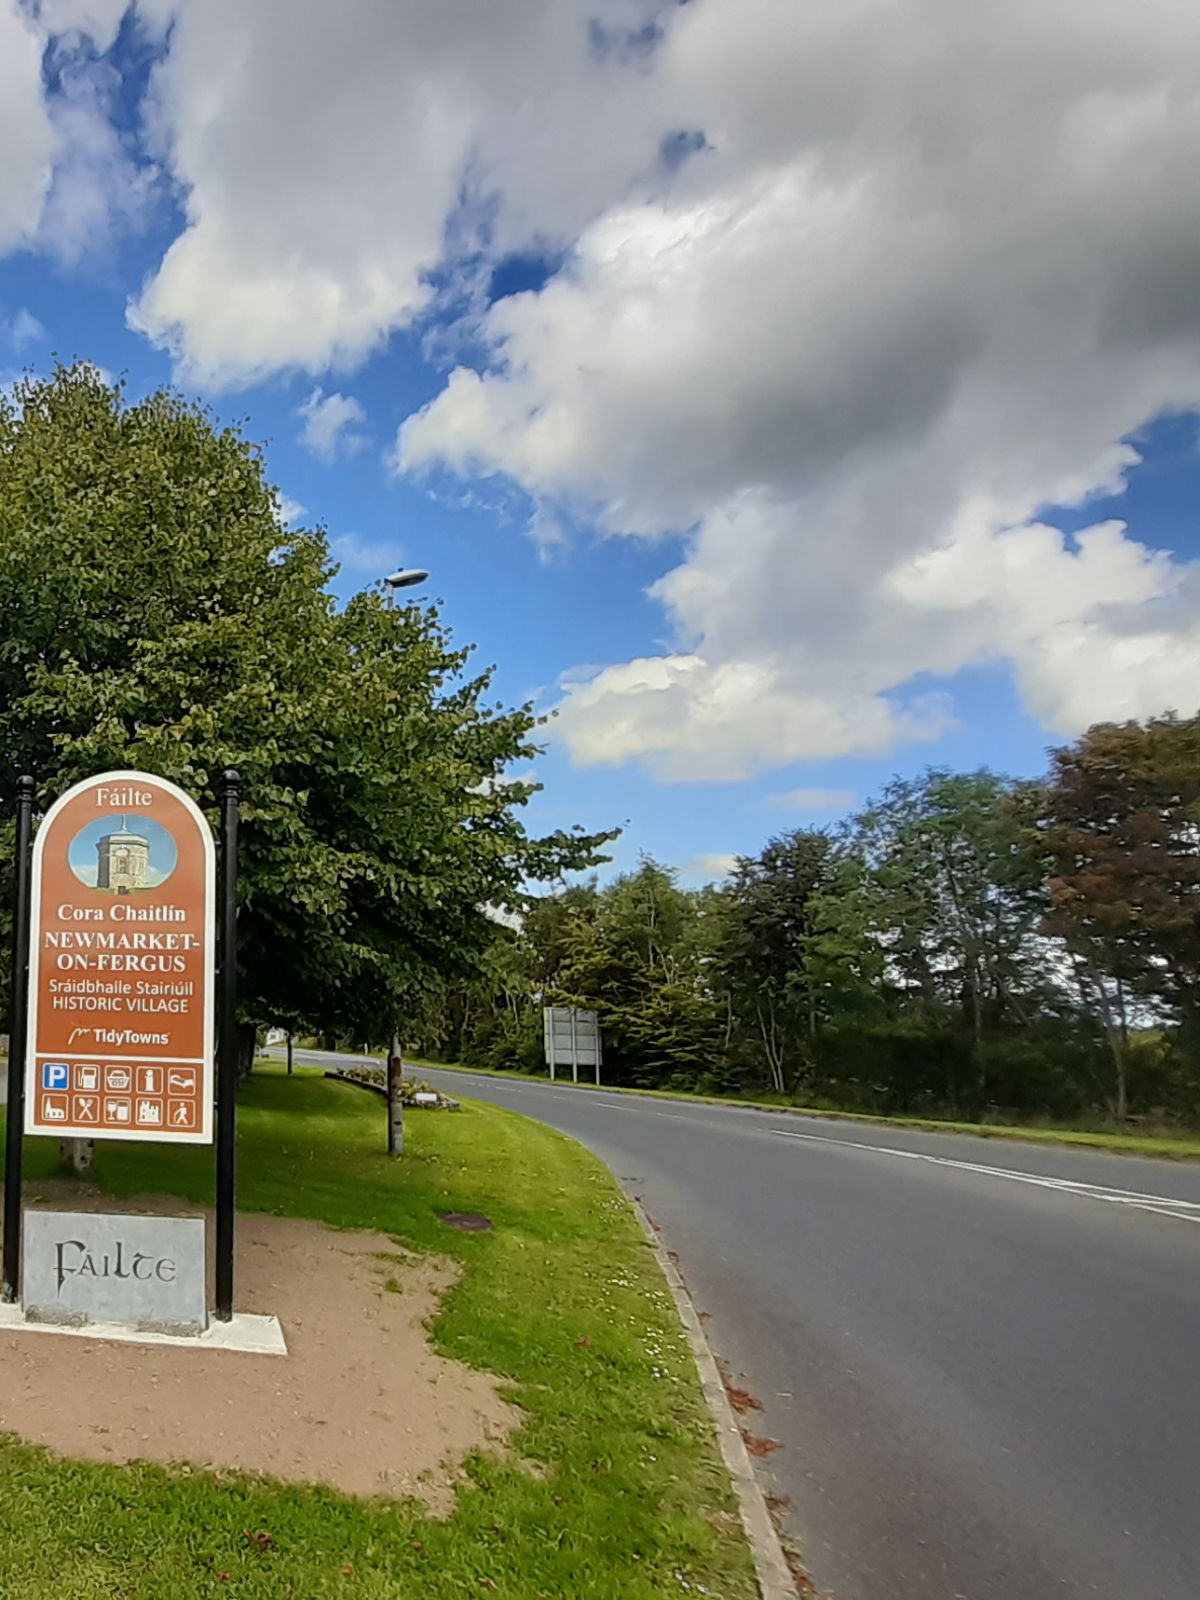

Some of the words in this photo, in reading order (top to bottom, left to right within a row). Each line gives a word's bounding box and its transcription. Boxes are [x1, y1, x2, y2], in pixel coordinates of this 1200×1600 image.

[96, 788, 152, 807] Fáilte
[58, 904, 104, 921] Cora
[110, 904, 186, 922] Chaitlín
[45, 932, 200, 950] NEWMARKET-
[57, 954, 186, 973] ON-FERGUS
[49, 979, 131, 995] Sráidbhaile
[137, 980, 193, 996] Stairiúil
[53, 996, 122, 1012] HISTORIC
[126, 999, 188, 1014] VILLAGE
[94, 1028, 169, 1046] TidyTowns
